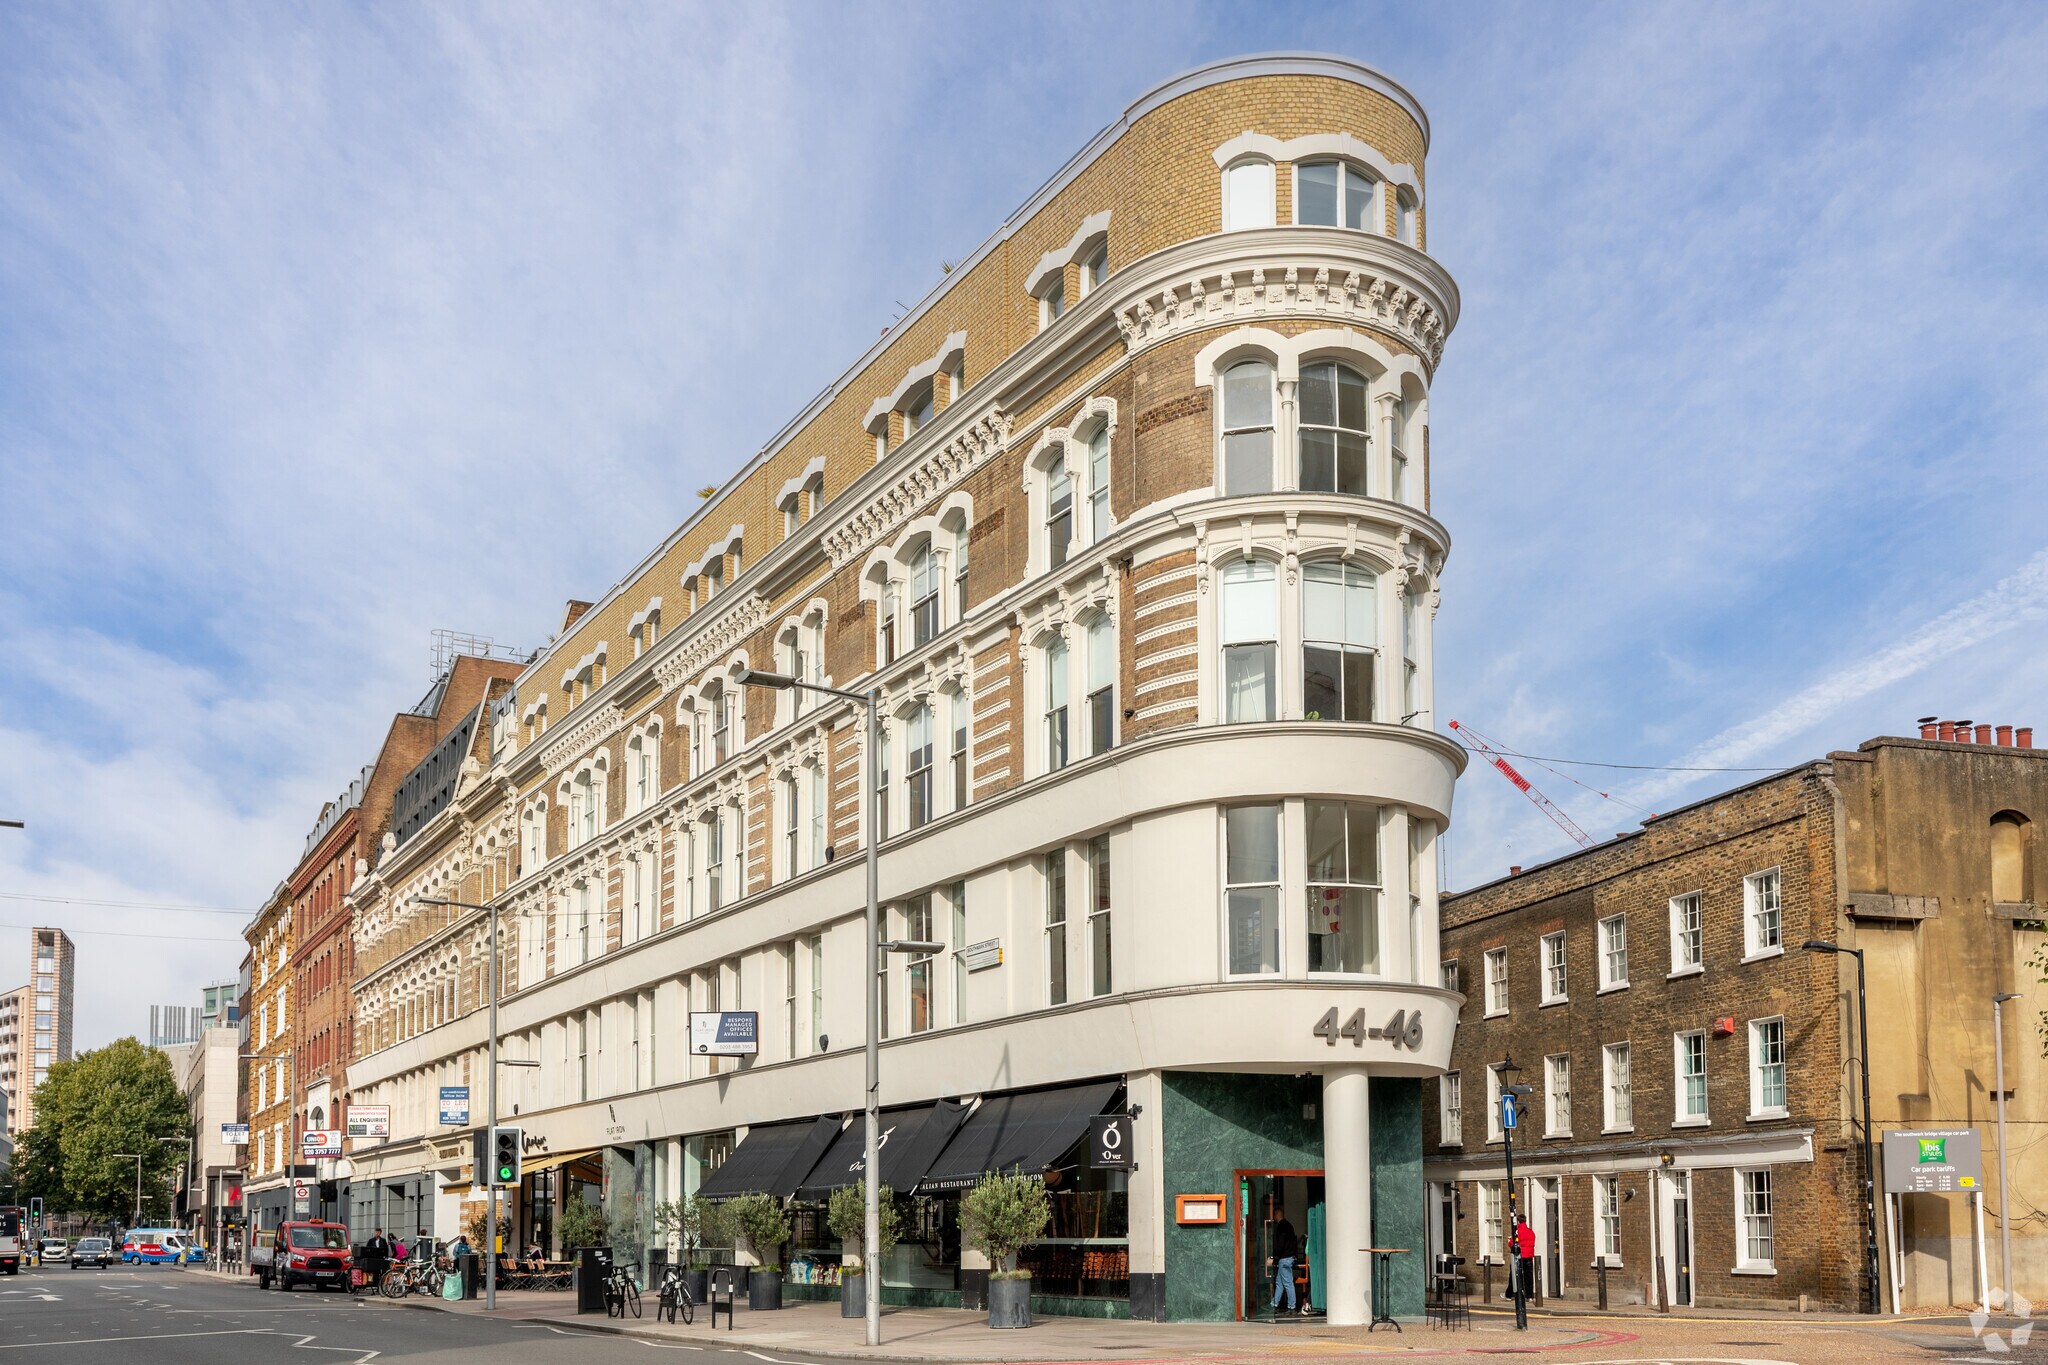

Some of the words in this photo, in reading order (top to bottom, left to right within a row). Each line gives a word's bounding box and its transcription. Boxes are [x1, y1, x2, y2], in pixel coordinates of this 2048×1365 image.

[1313, 1006, 1424, 1053] 44-46
[1924, 1143, 1940, 1151] ibis
[940, 1180, 974, 1188] RESTAURANT
